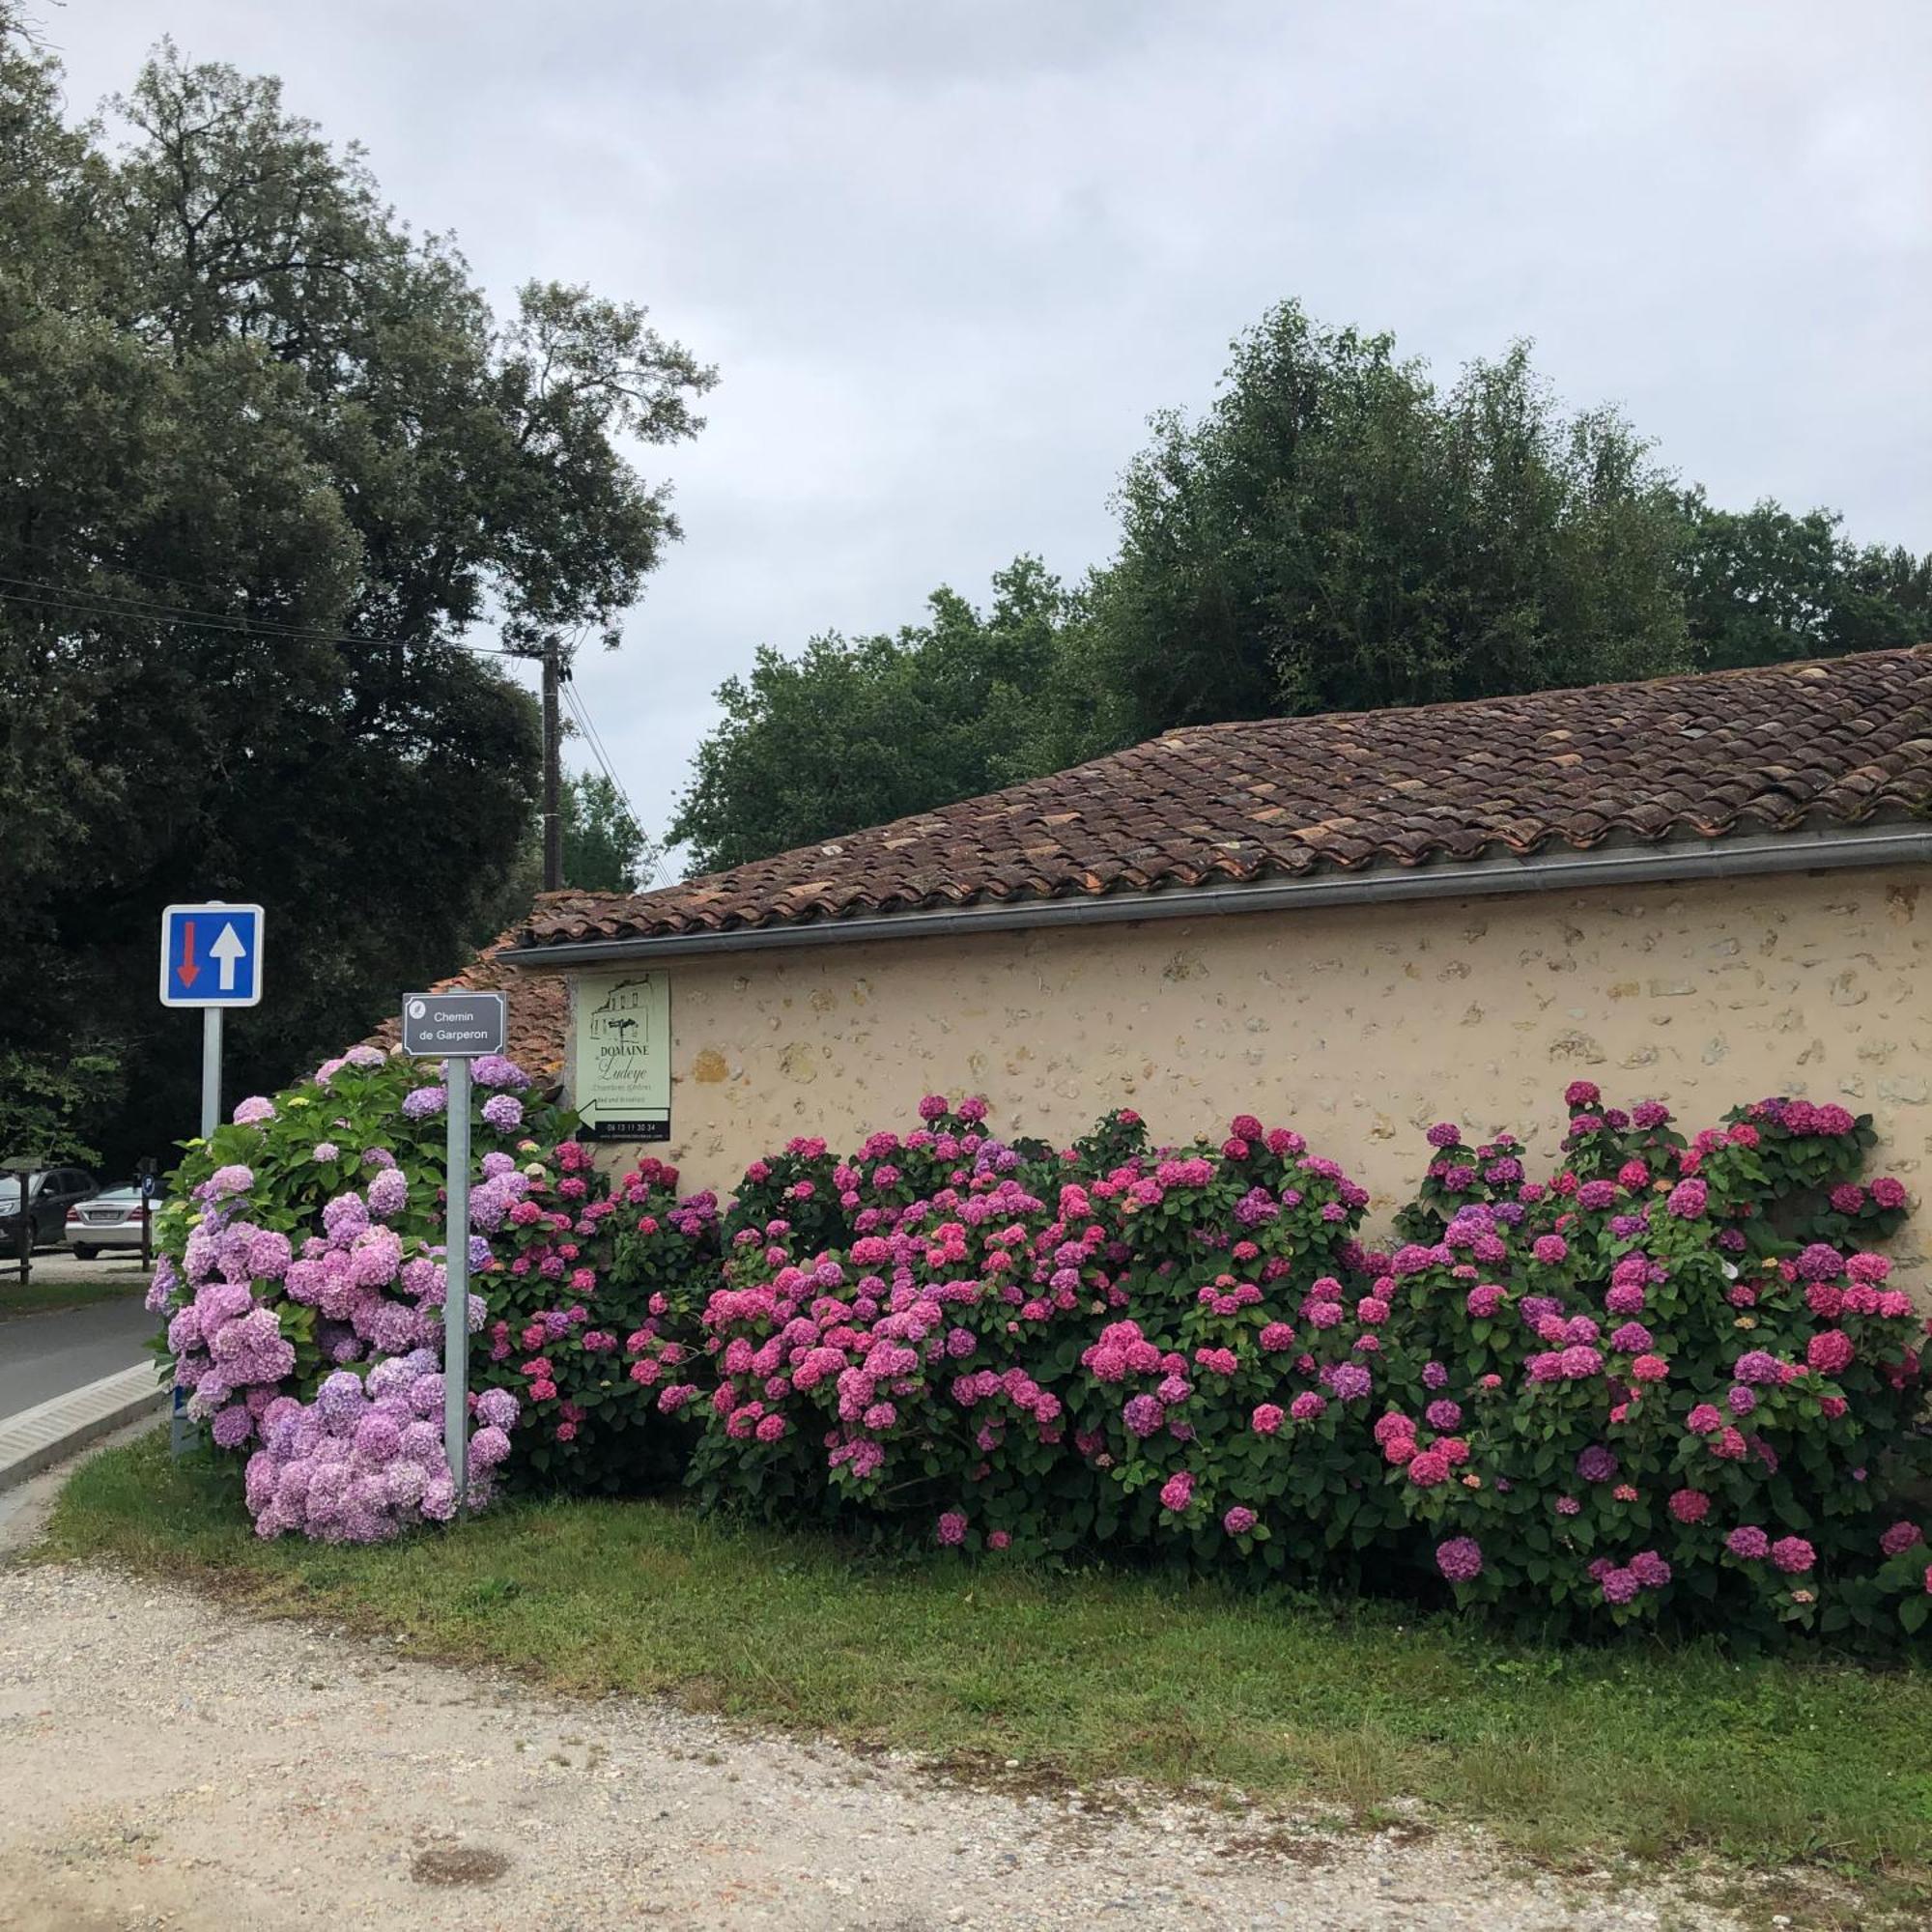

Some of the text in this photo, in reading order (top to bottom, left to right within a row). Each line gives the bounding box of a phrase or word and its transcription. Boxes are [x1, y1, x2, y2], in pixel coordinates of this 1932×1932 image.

[434, 1012, 473, 1022] Chemin
[419, 1030, 488, 1041] de Garperon
[601, 1046, 649, 1057] DOMAINE
[598, 1056, 648, 1083] Ludeye
[147, 1179, 152, 1189] P
